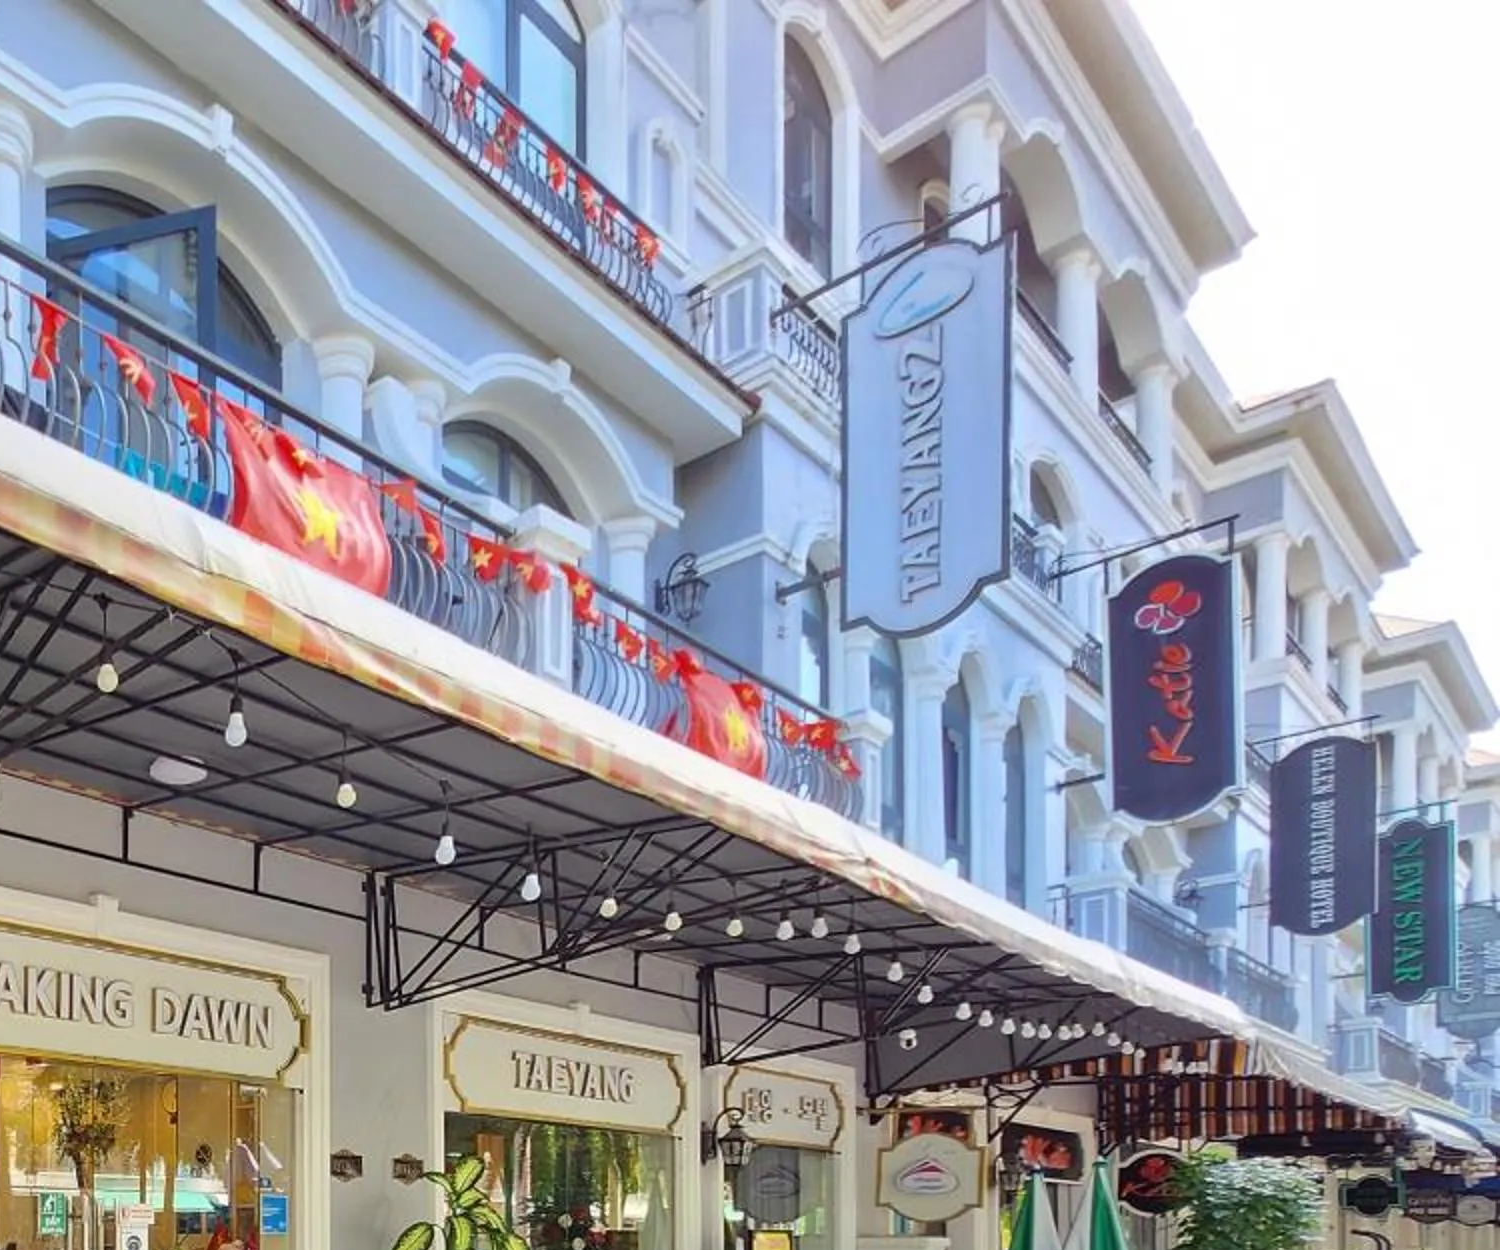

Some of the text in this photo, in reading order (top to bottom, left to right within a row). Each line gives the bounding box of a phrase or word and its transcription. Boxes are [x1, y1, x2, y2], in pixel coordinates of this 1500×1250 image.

[1148, 642, 1194, 765] Katie
[1310, 799, 1335, 876] BOUTIQUE
[1310, 876, 1335, 929] HOTEL
[1392, 837, 1425, 984] NEW STAR
[151, 986, 275, 1050] DAWN
[511, 1050, 636, 1104] TAEYANG
